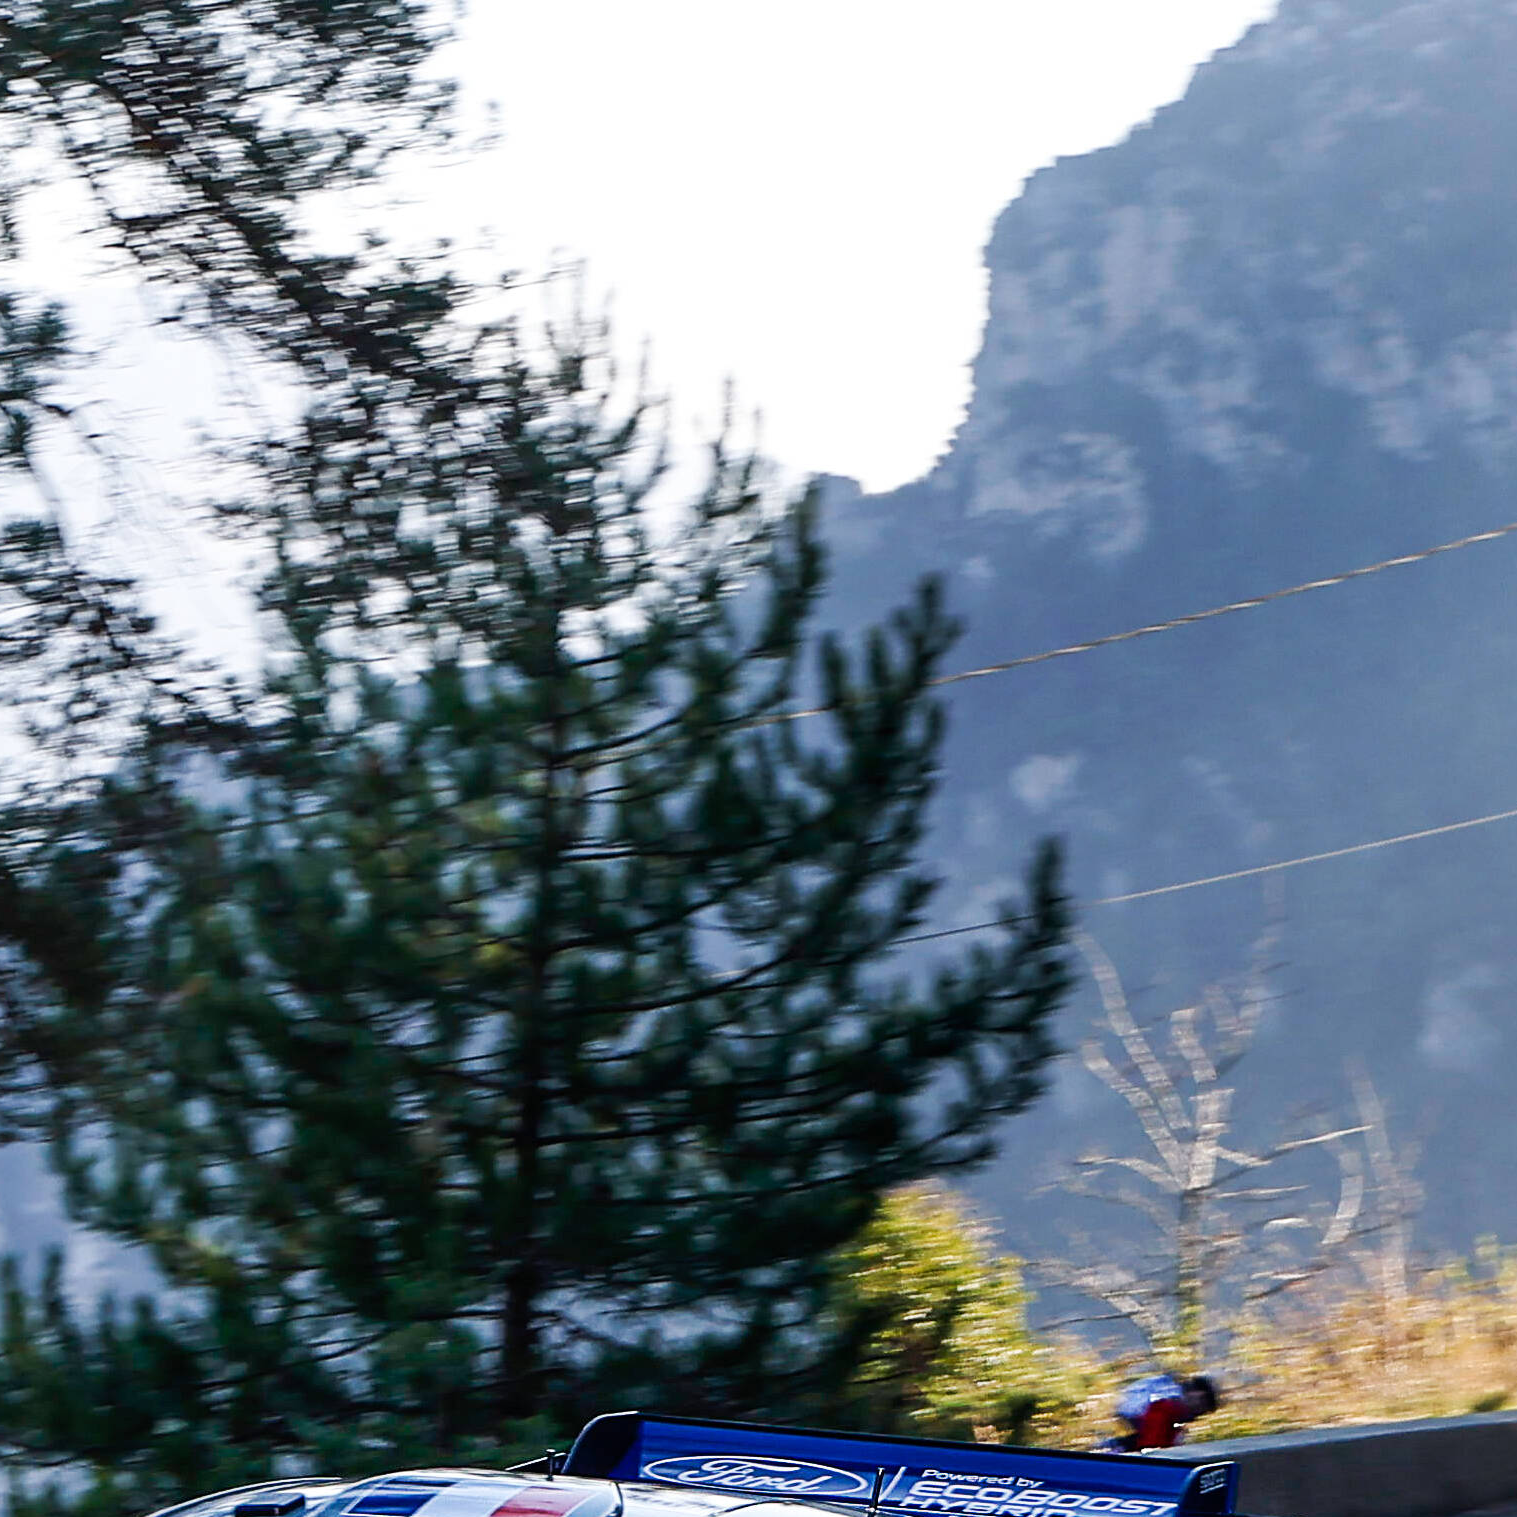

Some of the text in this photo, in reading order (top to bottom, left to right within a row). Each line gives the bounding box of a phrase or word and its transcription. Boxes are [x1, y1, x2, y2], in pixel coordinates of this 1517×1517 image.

[677, 1459, 833, 1492] Ford
[921, 1469, 1045, 1490] Powered by
[910, 1480, 1179, 1517] ECOBOOST
